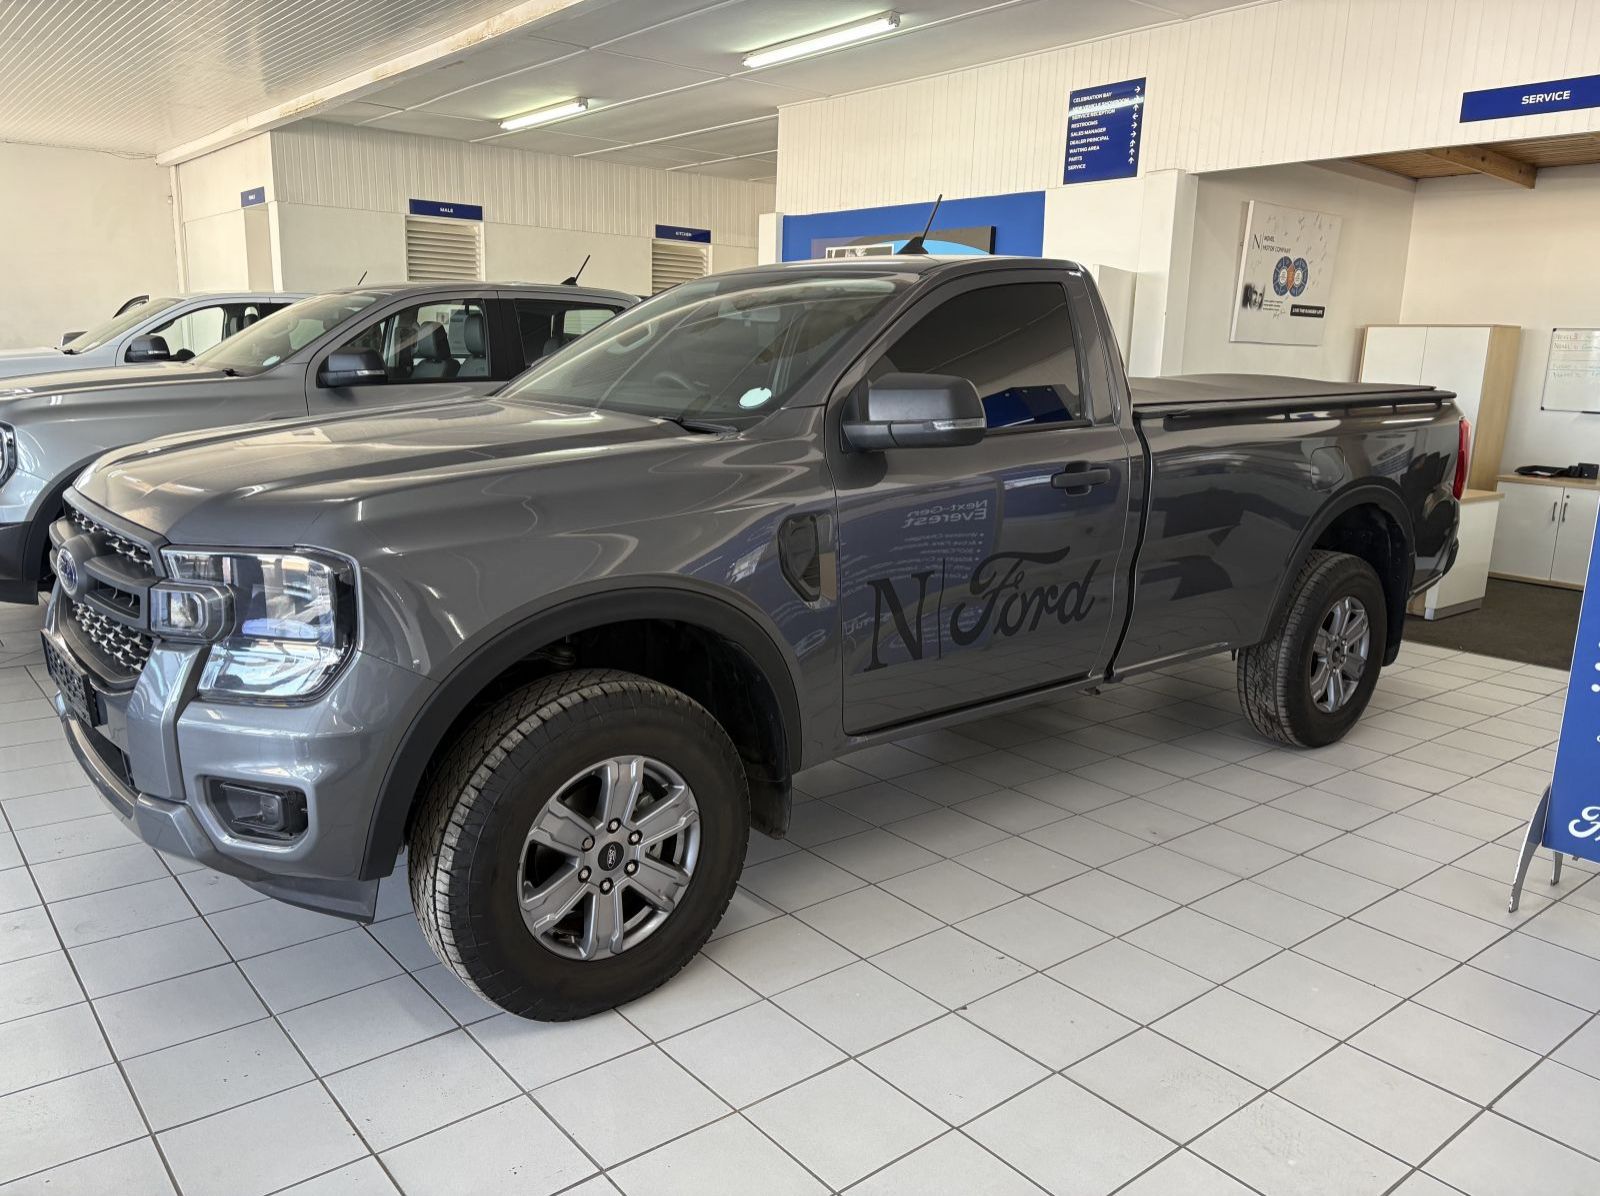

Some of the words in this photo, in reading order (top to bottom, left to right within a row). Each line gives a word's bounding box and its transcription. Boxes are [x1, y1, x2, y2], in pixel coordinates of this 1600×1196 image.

[1073, 93, 1103, 103] CELEBRATION
[1520, 90, 1571, 105] SERVICE
[1090, 108, 1116, 117] RECEPTION
[1071, 120, 1098, 128] RESTROOMS
[1084, 127, 1107, 135] MANAGER
[1069, 138, 1087, 146] DEALER
[1087, 135, 1110, 143] PRINCIPAL
[863, 570, 935, 672] N
[950, 546, 1101, 646] Ford
